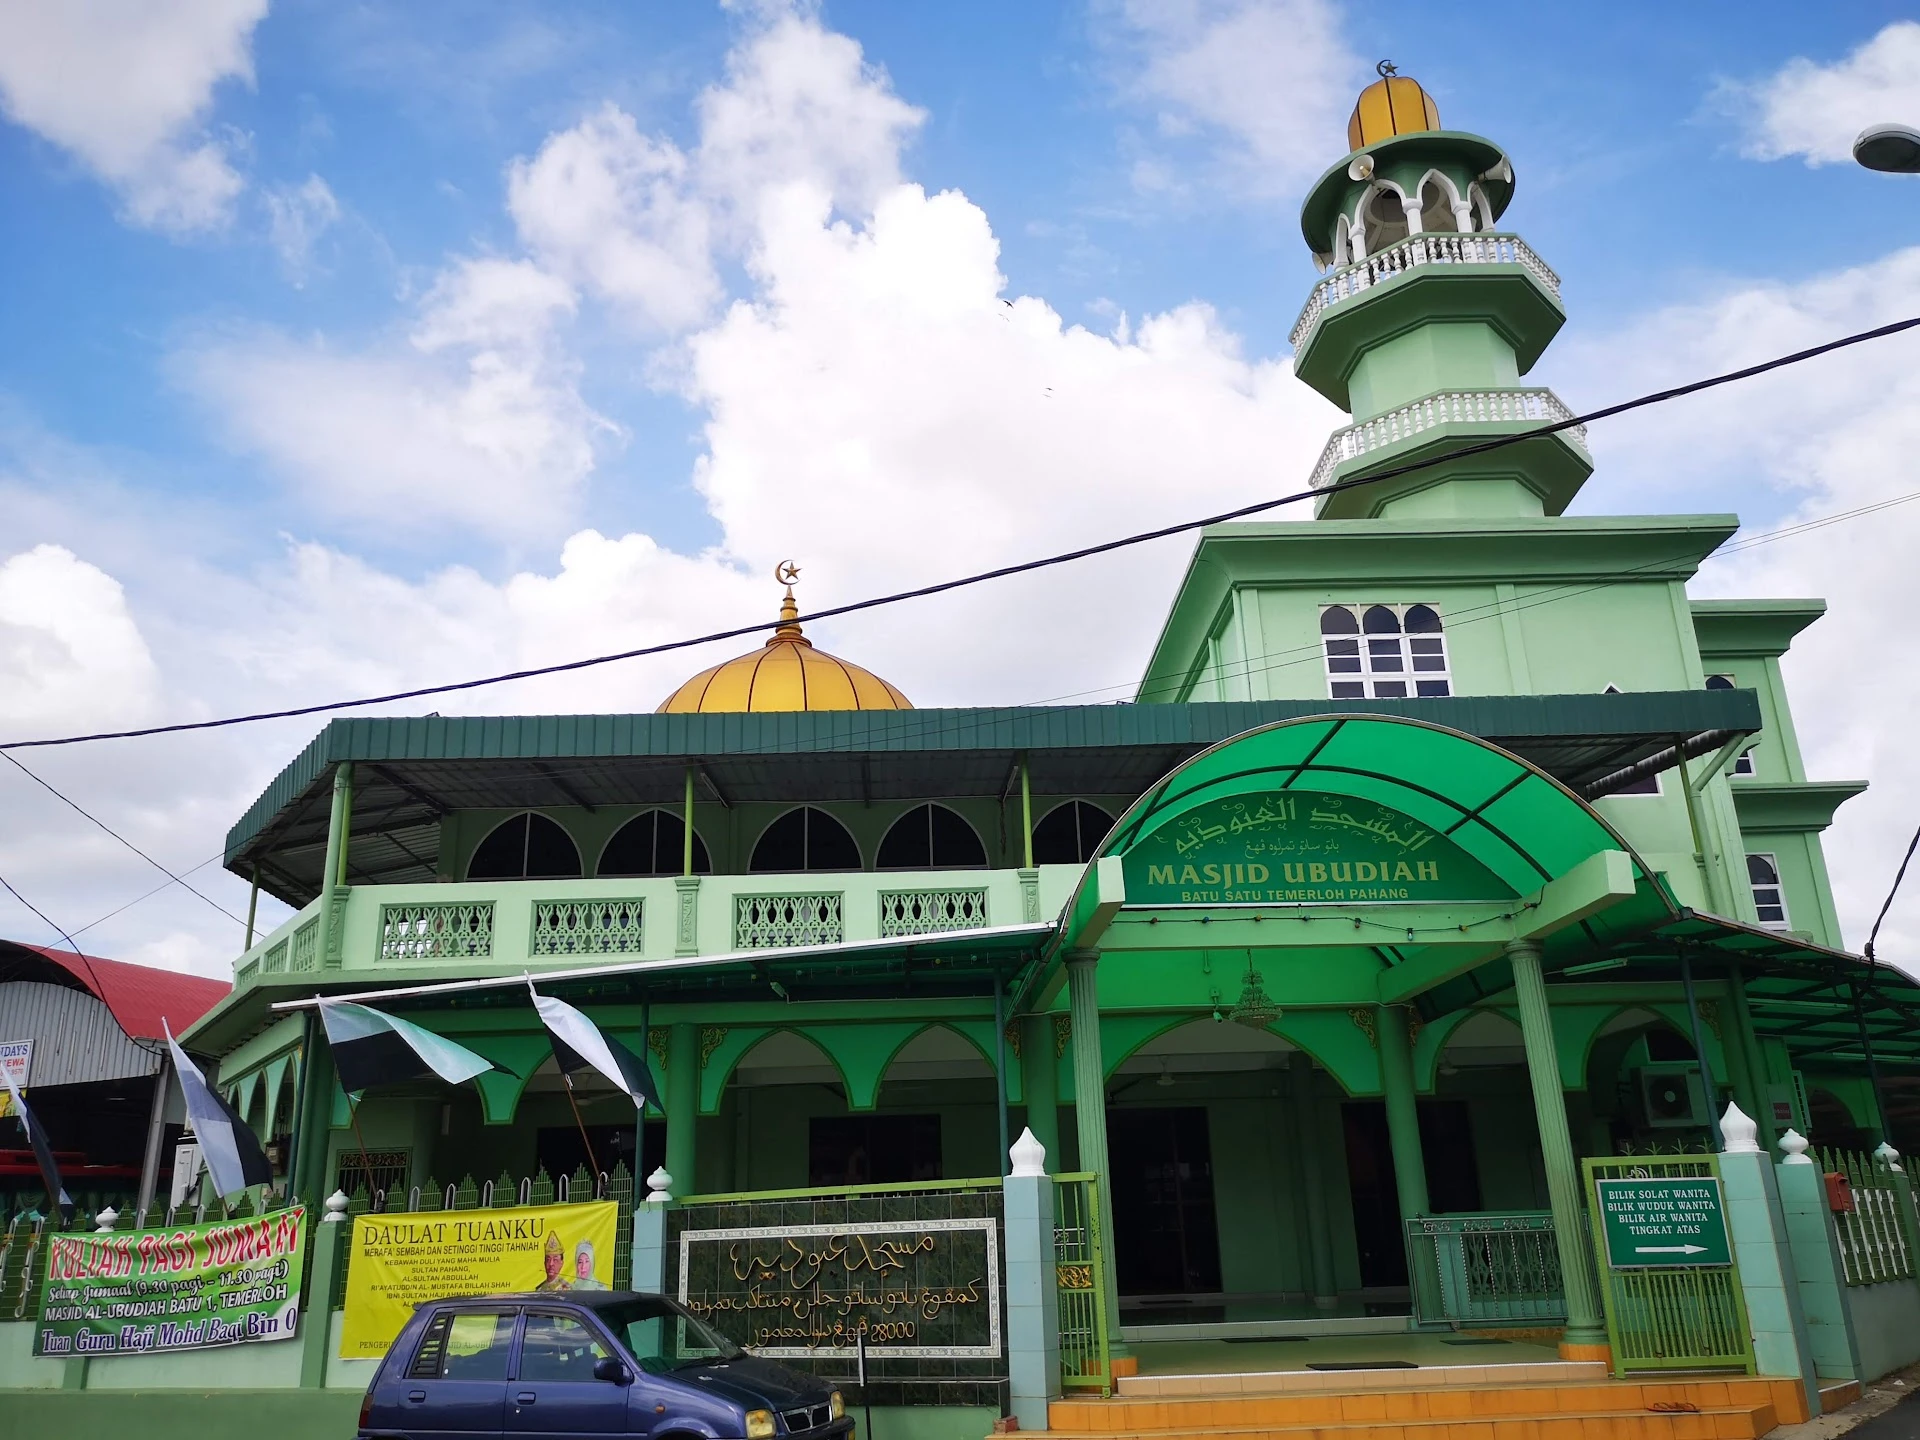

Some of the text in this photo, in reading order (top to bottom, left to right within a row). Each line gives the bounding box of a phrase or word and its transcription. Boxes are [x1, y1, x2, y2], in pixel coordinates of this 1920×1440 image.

[1148, 861, 1439, 889] MASJID UBUDIAH
[1182, 888, 1408, 902] BATU SATU TEMERLOH PAHANG
[5, 1058, 24, 1067] EWA
[1608, 1189, 1710, 1200] BILIK SOLAT WANITA
[1607, 1201, 1715, 1211] BILIK WUDUK WANITA
[1618, 1213, 1708, 1223] BILIK AIR WANITA
[363, 1218, 545, 1245] DAULAT TUANKU
[1629, 1225, 1700, 1235] TINGKAT ATAS
[49, 1236, 134, 1280] KULIAH
[136, 1230, 196, 1275] PAGI
[396, 1246, 425, 1256] SEMBAH
[426, 1245, 442, 1255] DAN
[443, 1244, 478, 1254] SETINGGI
[479, 1243, 504, 1253] TINGGI
[505, 1242, 539, 1252] TAHNIAH
[411, 1266, 438, 1274] SULTAN
[170, 1275, 204, 1297] pagi
[220, 1269, 253, 1288] 11.30
[45, 1284, 288, 1321] MASJID AL-UBUDIAH BATU 1, TEMERLOH
[42, 1329, 71, 1352] Tuan
[75, 1327, 116, 1351] Guru
[119, 1325, 155, 1352] Haji
[157, 1319, 205, 1346] Mohd
[207, 1318, 244, 1344] Baqi
[247, 1311, 278, 1336] Bin
[871, 1321, 915, 1343] 28000
